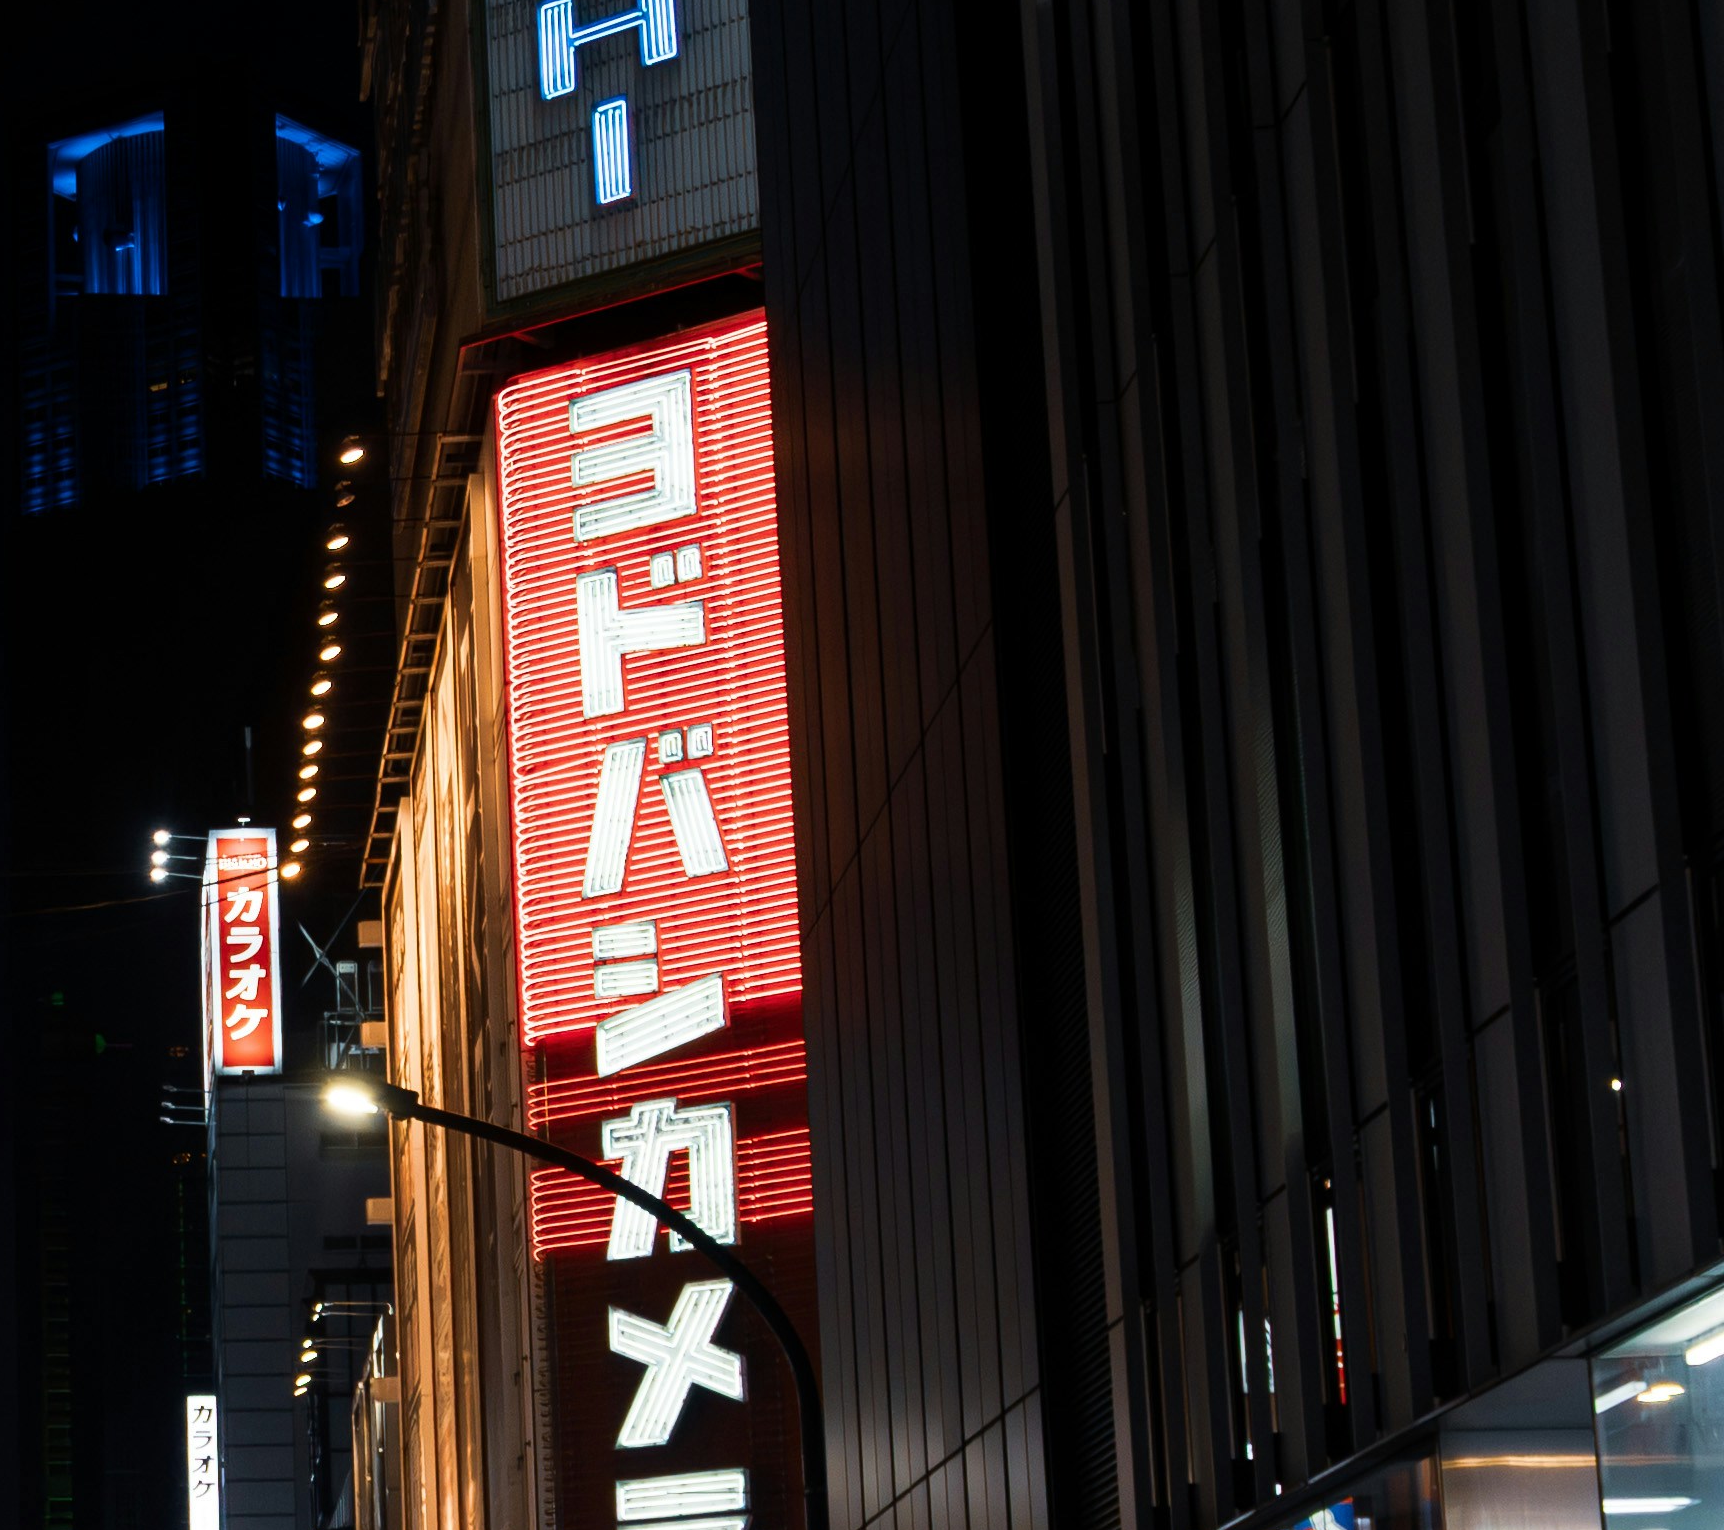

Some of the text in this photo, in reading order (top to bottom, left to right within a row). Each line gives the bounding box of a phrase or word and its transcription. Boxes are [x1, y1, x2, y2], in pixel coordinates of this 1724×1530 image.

[224, 886, 268, 1041] カラオケ
[193, 1404, 217, 1499] カラオケ
